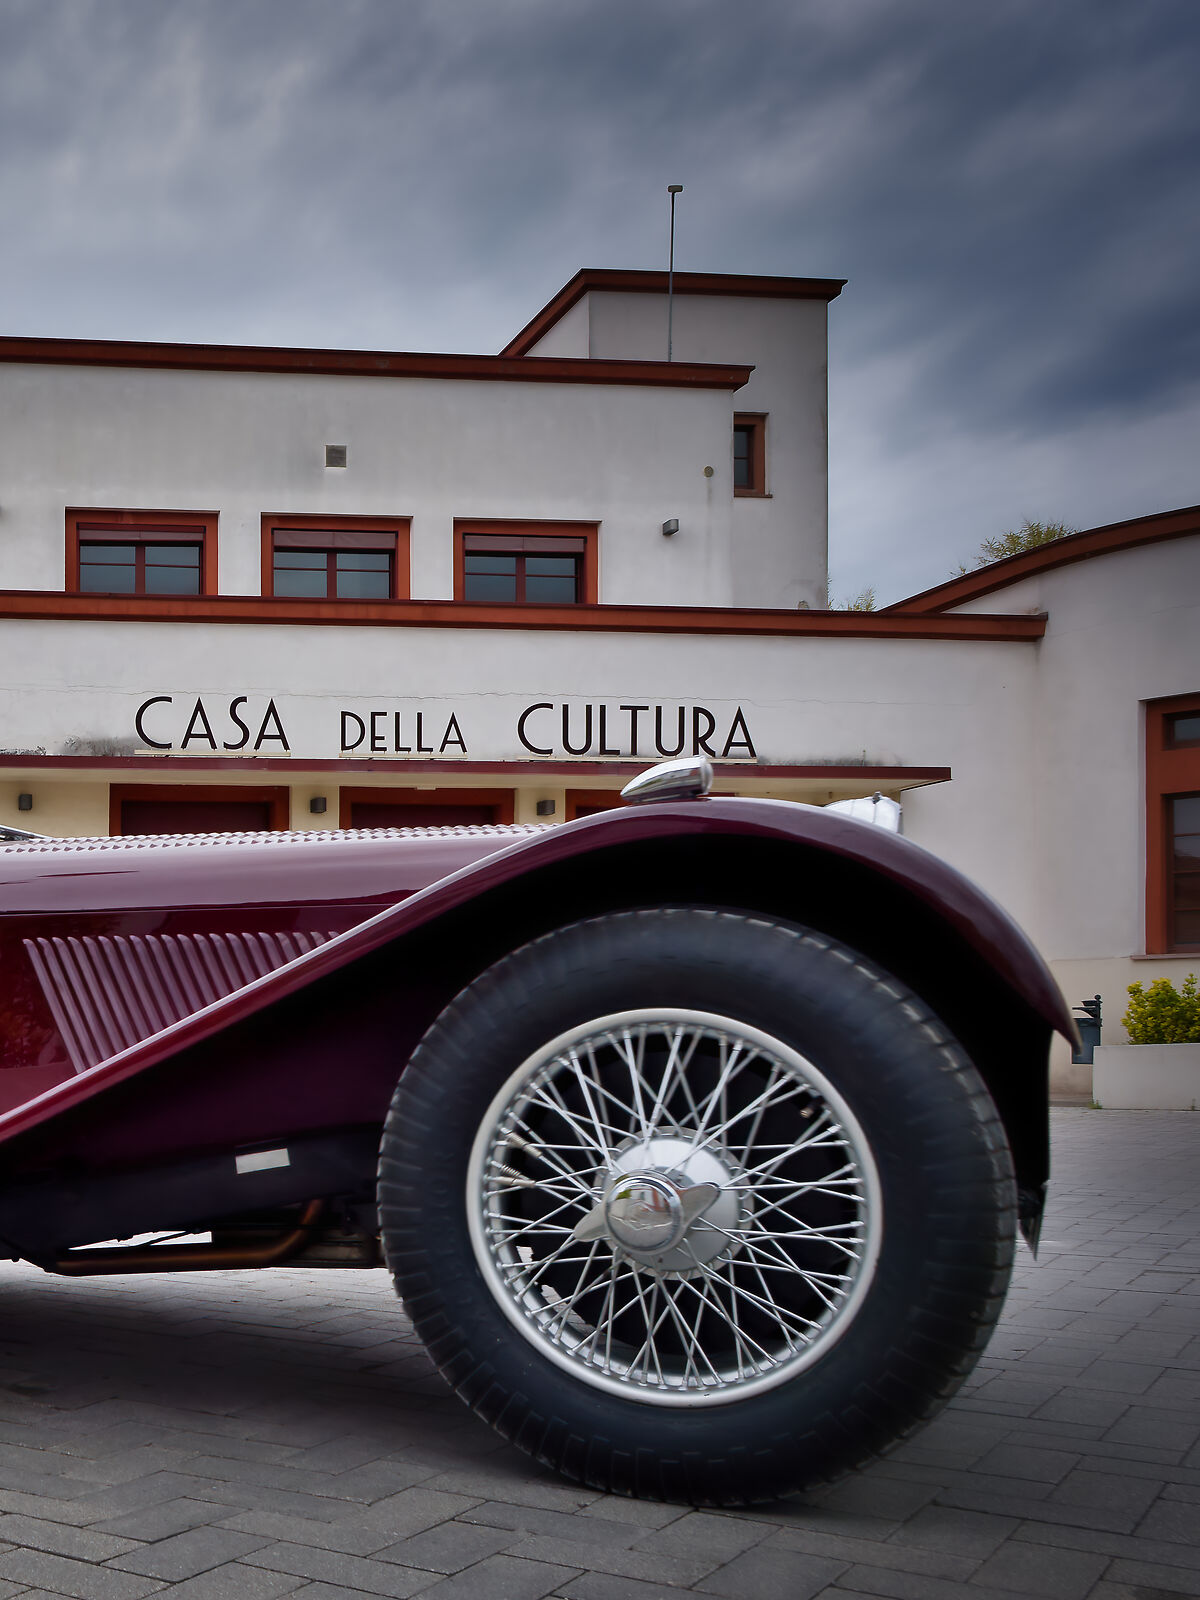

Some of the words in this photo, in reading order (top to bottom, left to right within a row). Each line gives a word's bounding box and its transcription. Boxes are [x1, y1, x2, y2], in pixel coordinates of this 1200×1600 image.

[135, 696, 290, 750] CASA
[341, 711, 467, 752] DELLA
[518, 703, 756, 758] CULTURA
